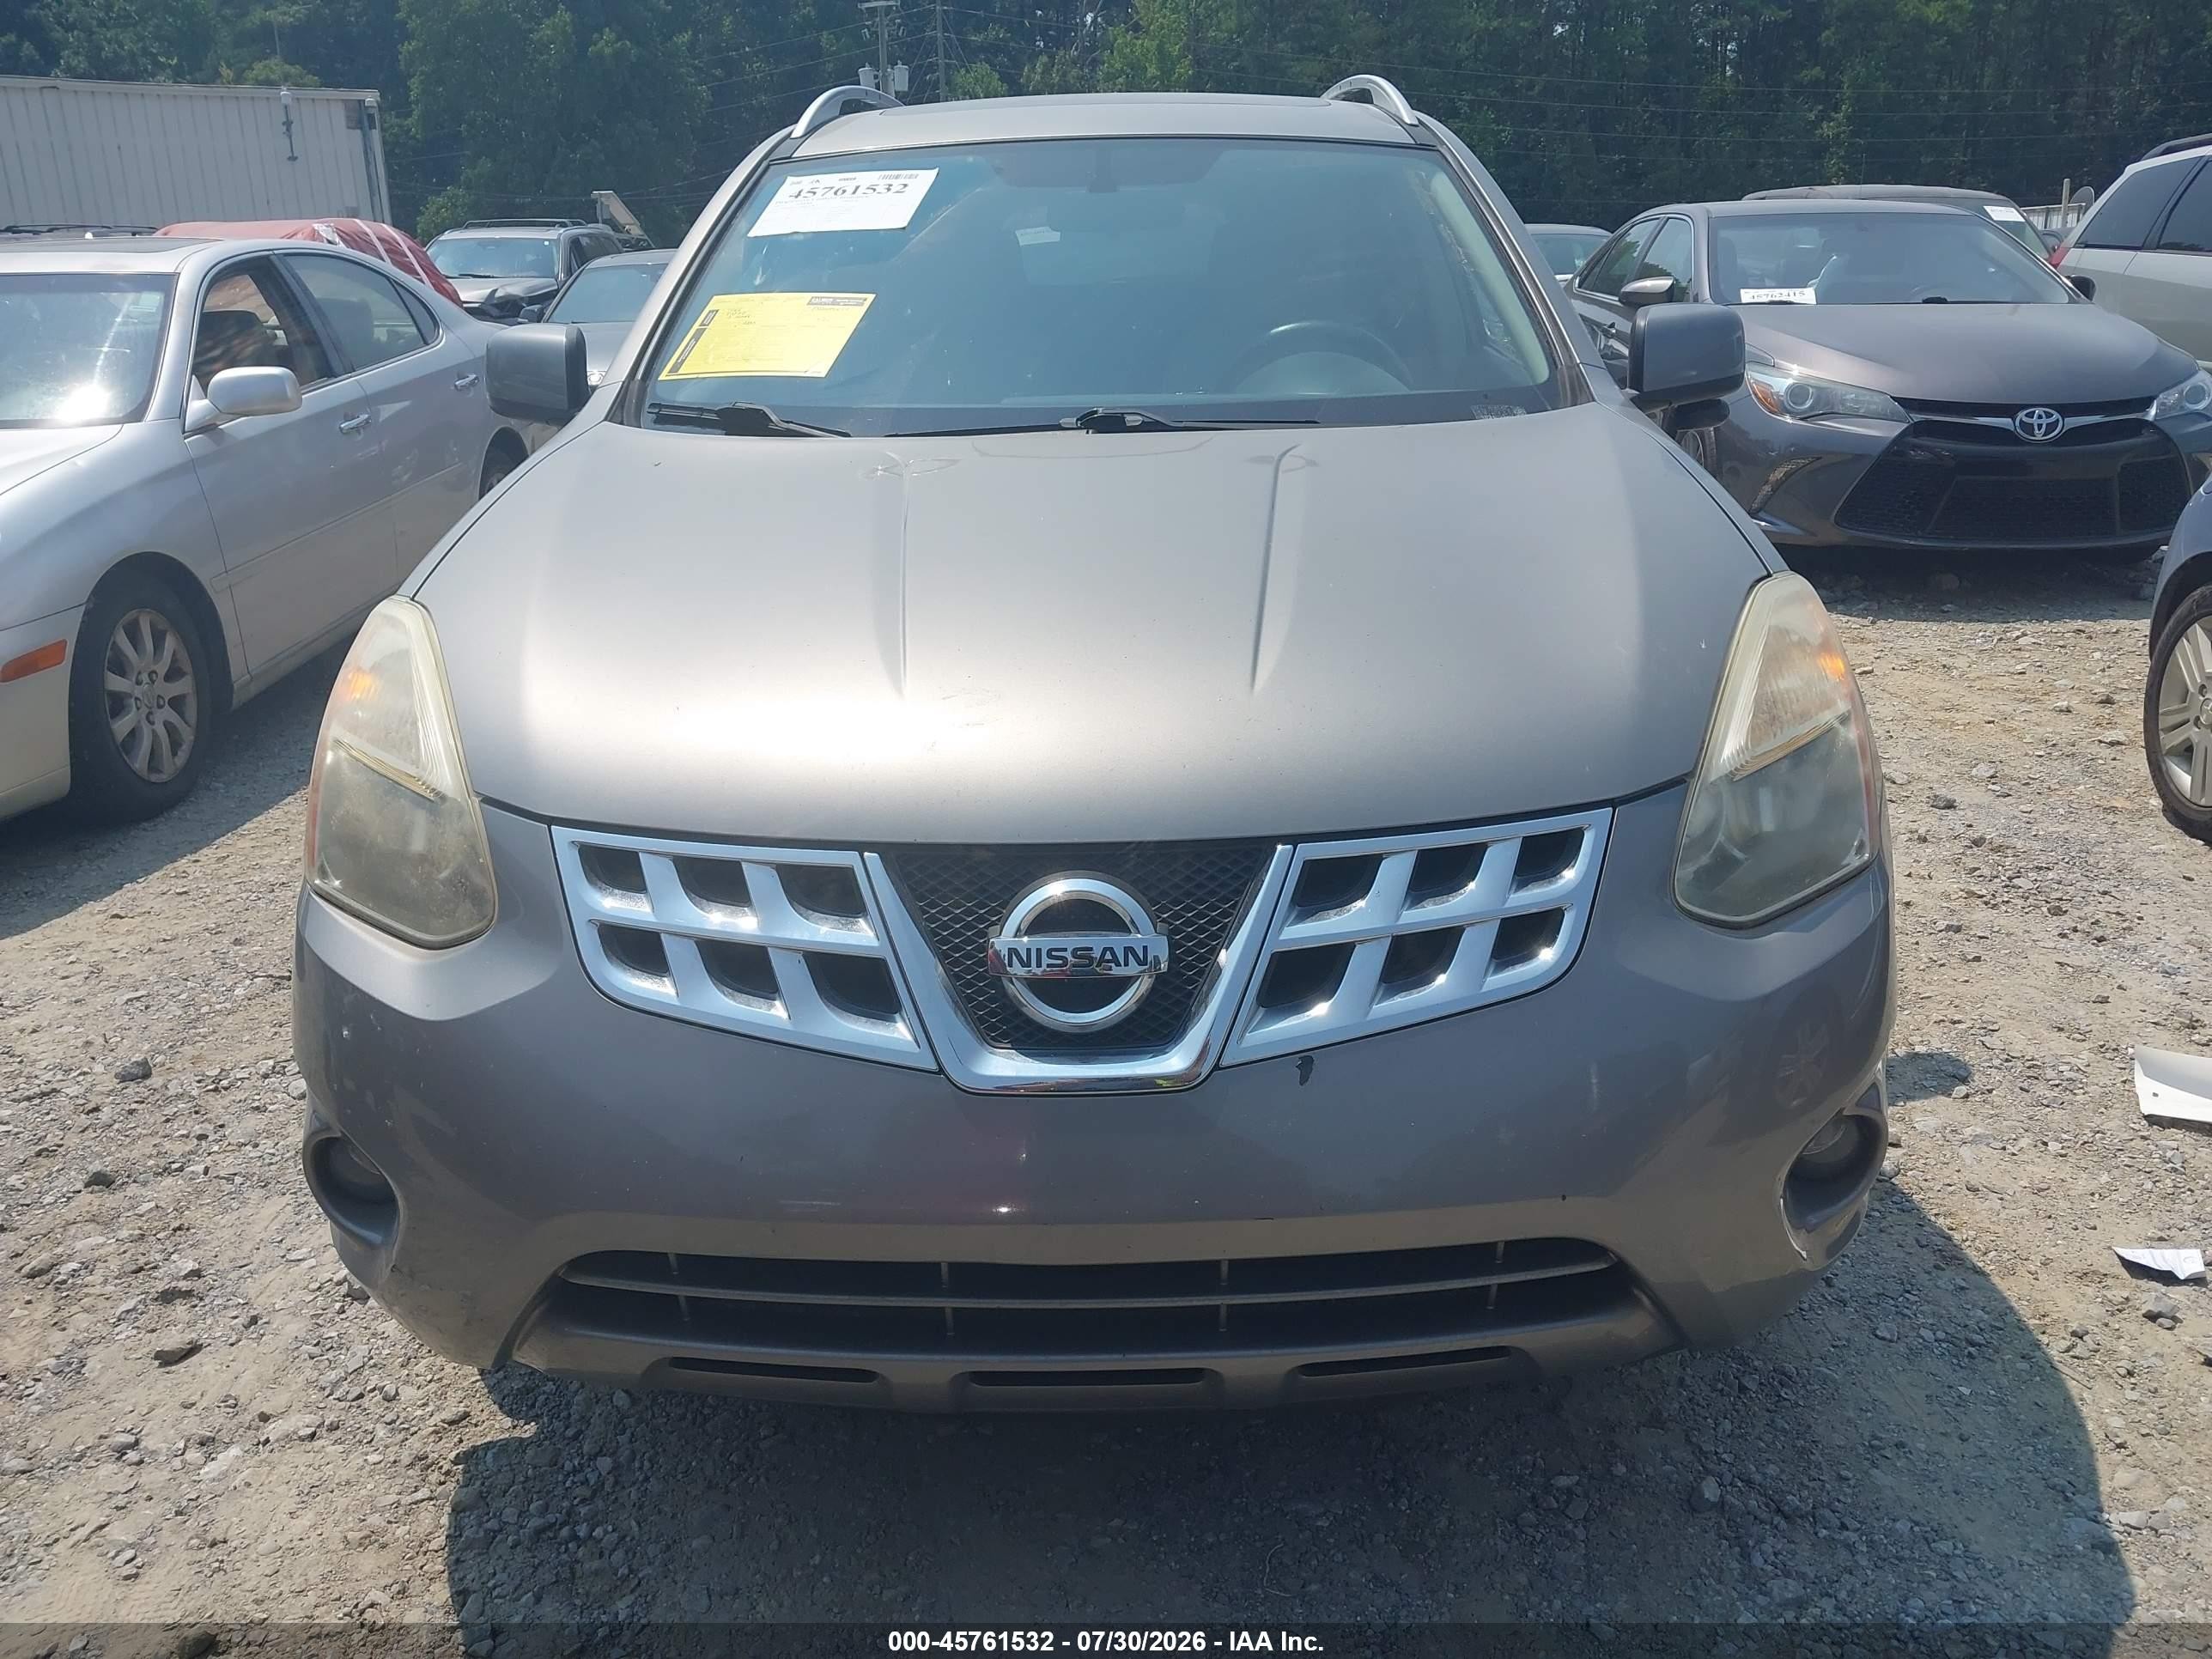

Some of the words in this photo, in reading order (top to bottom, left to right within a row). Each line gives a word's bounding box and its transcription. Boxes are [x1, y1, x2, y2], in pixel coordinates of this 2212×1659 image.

[789, 183, 909, 198] 45761532
[1750, 291, 1806, 300] 45762415
[1006, 945, 1150, 969] NISSAN
